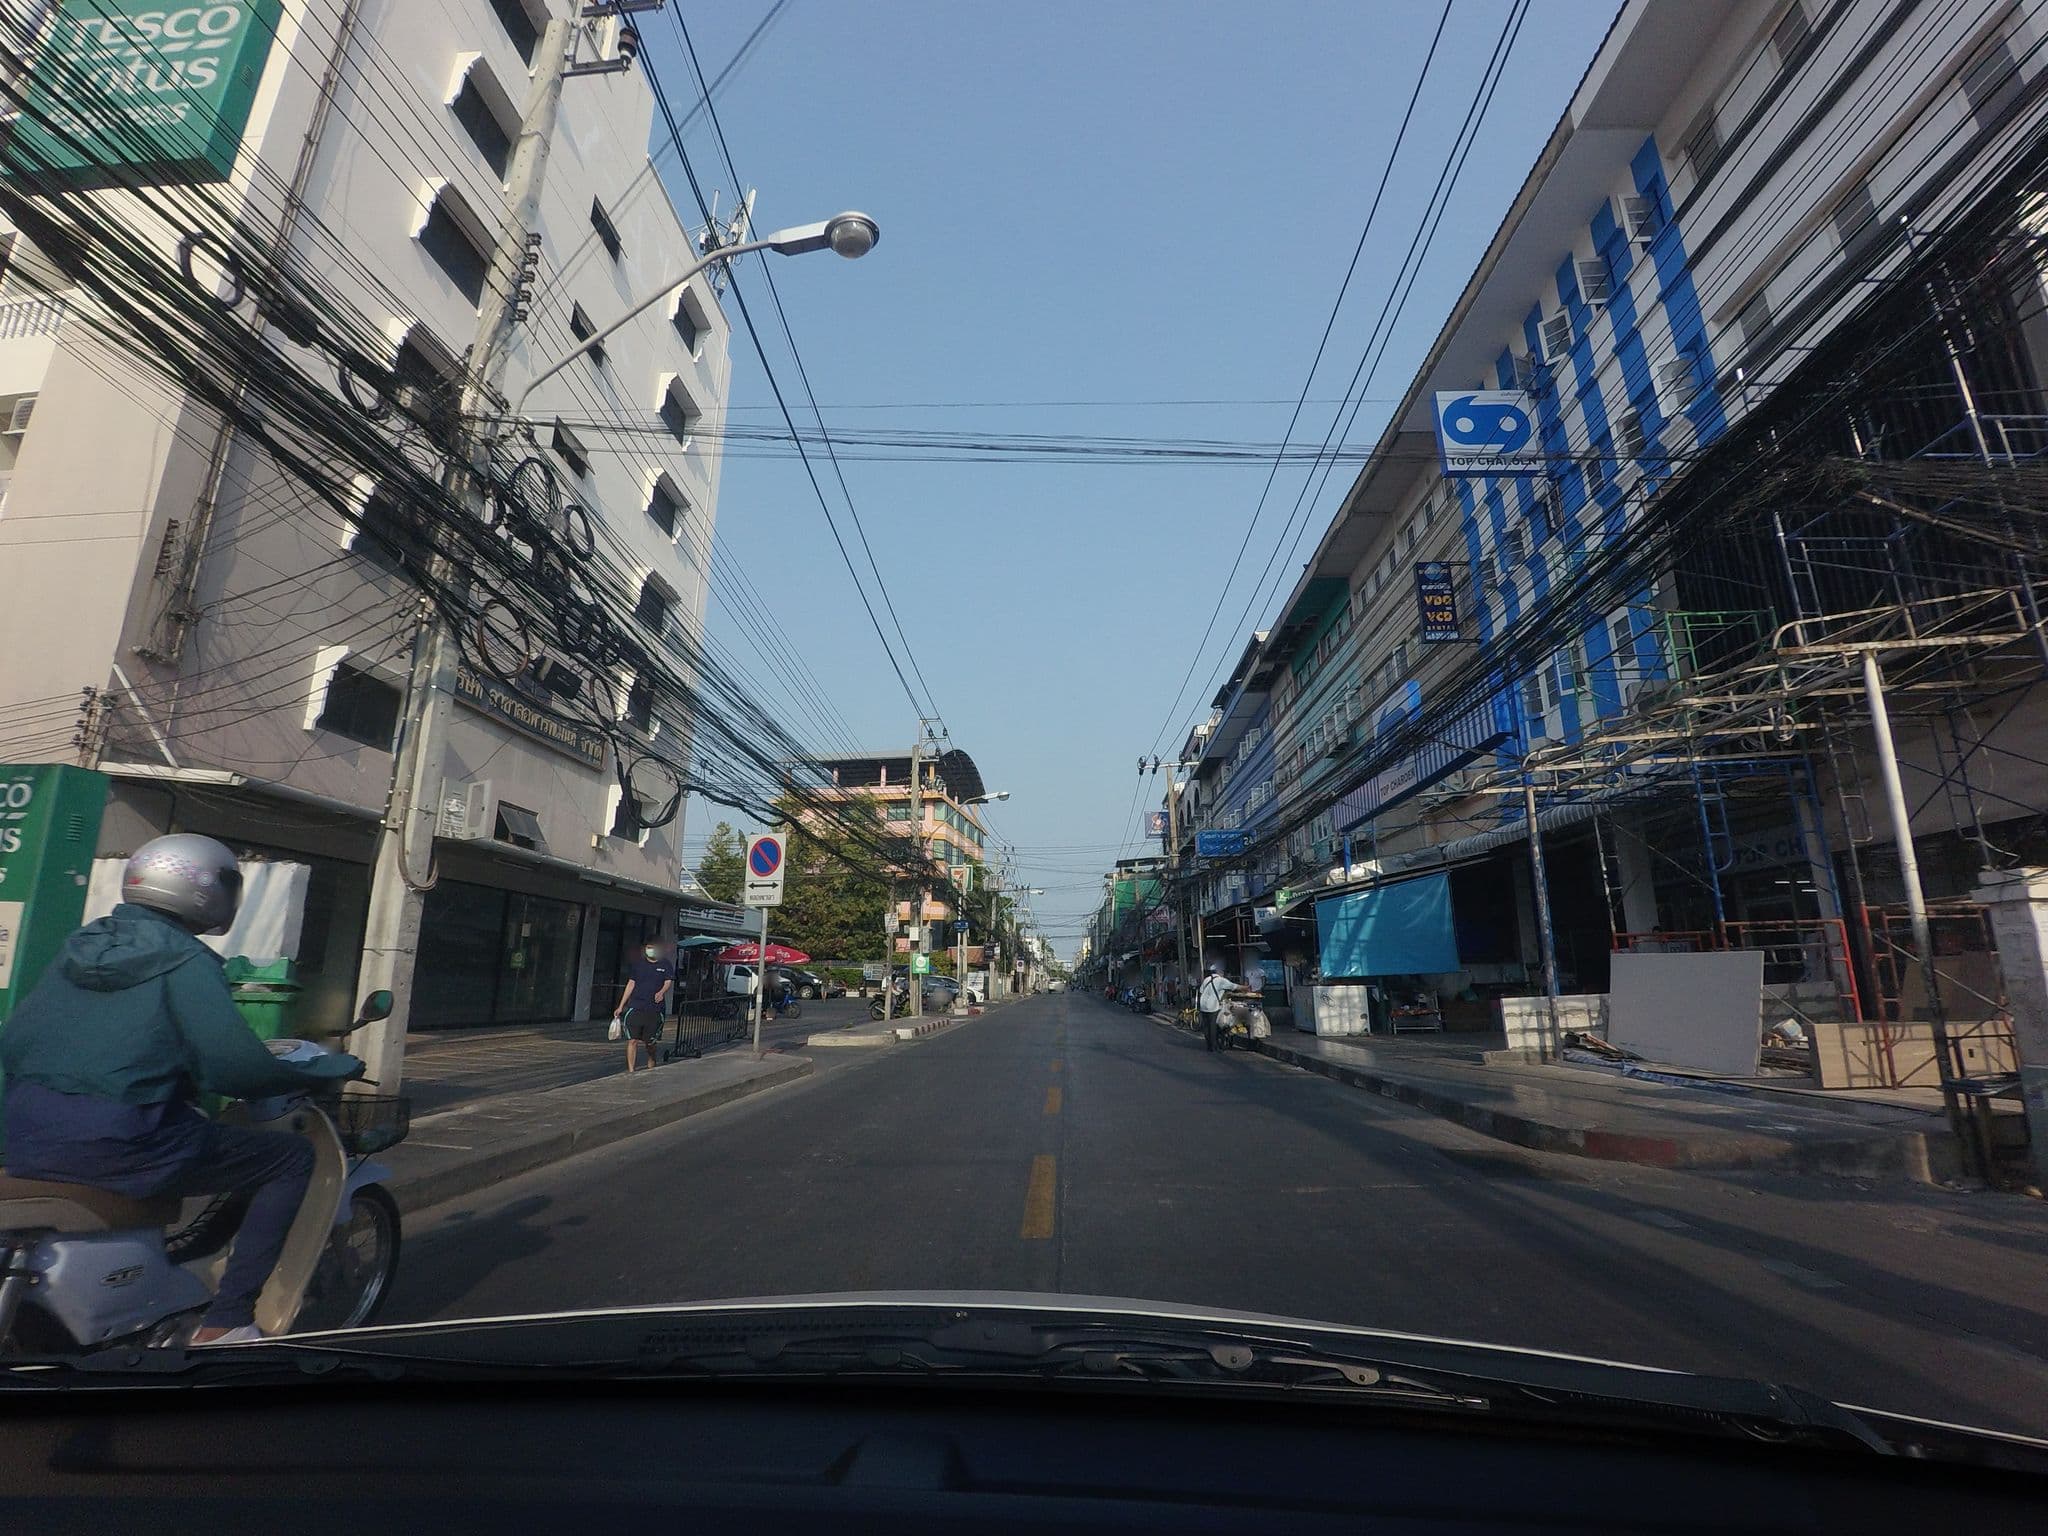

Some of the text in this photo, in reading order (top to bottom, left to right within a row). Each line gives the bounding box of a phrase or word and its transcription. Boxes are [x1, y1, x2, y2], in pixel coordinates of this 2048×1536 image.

[70, 5, 241, 48] TESCO
[1450, 456, 1473, 466] TOP
[1426, 611, 1453, 622] VCD
[456, 665, 483, 700] ริษัท
